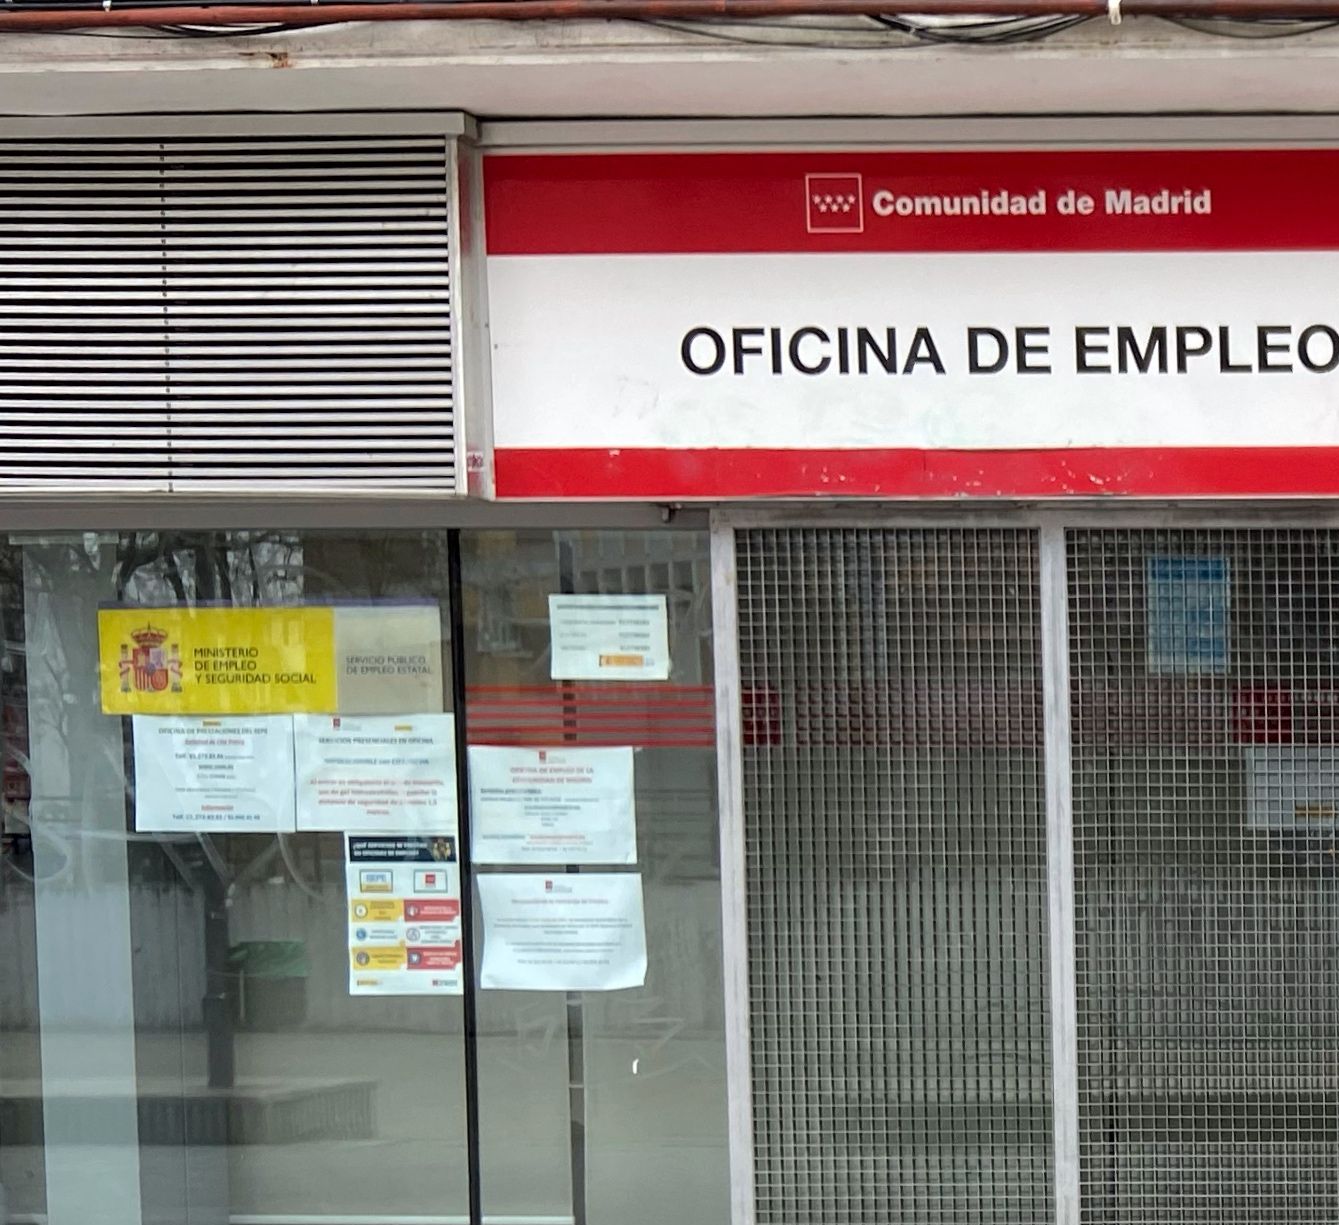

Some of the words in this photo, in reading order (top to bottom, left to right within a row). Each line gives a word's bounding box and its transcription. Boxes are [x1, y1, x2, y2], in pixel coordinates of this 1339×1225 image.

[872, 188, 1047, 216] Comunidad
[1056, 188, 1095, 215] de
[1104, 188, 1212, 215] Madrid
[681, 326, 946, 375] OFICINA
[967, 326, 1052, 374] DE
[194, 648, 259, 659] MINISTERIO
[195, 661, 210, 671] DE
[213, 661, 257, 671] EMPLEO
[195, 673, 203, 684] Y
[205, 673, 271, 684] SEGURIDAD
[275, 673, 316, 684] SOCIAL
